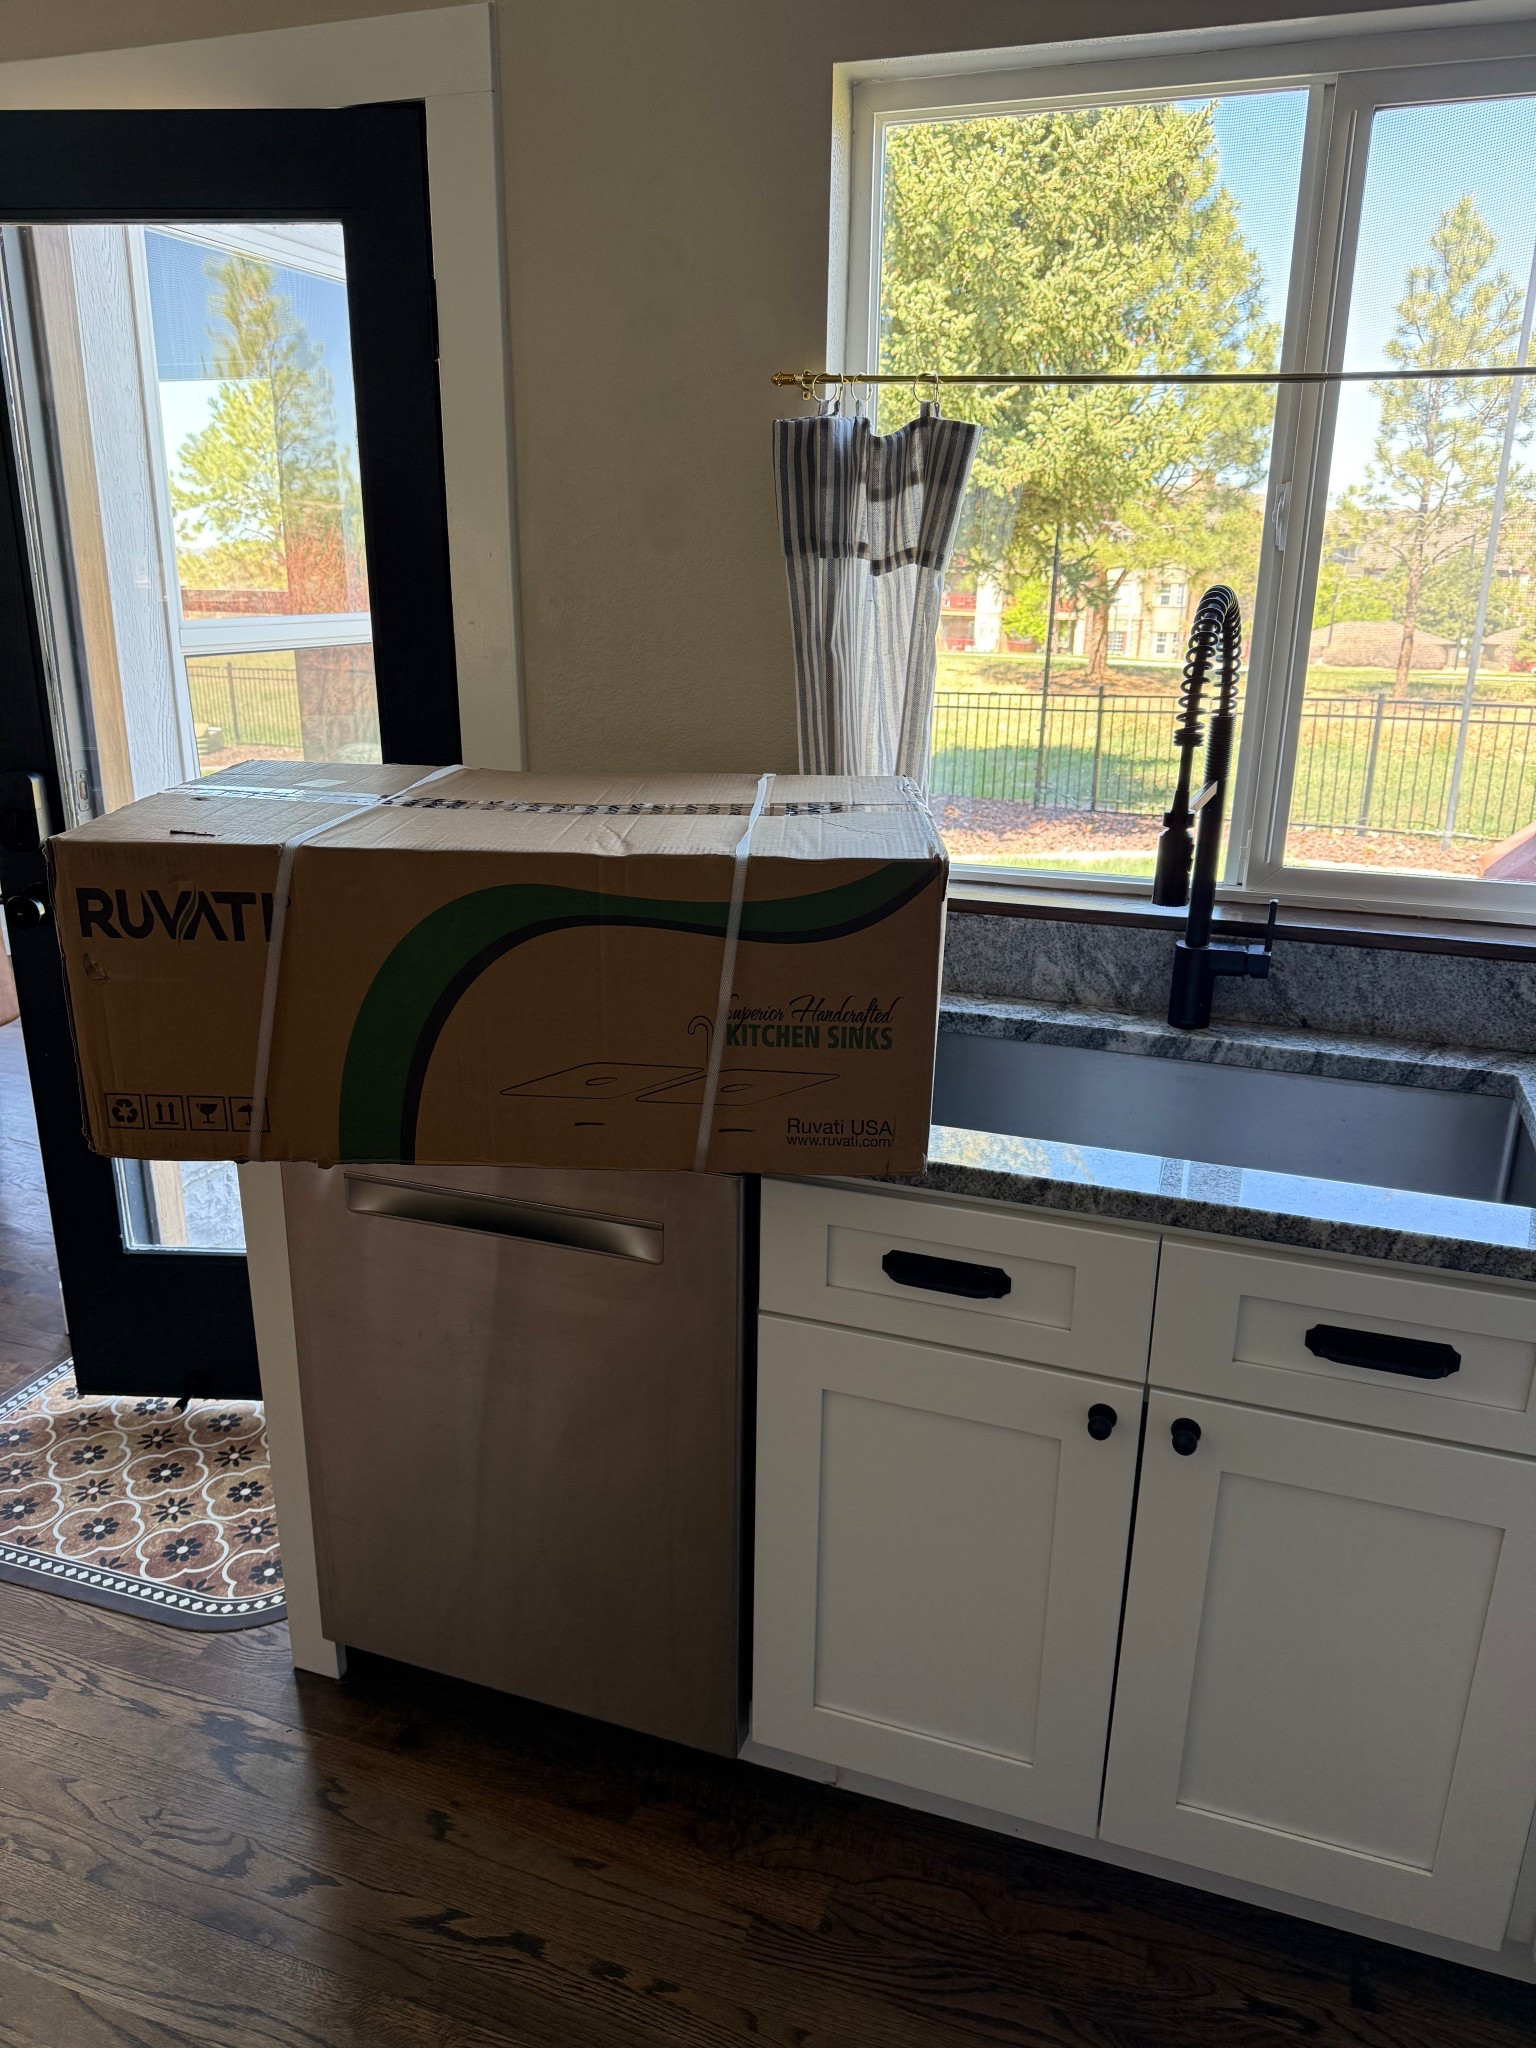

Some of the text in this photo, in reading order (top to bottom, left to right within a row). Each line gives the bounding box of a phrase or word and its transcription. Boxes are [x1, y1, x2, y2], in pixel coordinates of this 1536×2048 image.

[76, 887, 273, 944] RUVATI
[789, 994, 904, 1031] Handcrafted
[726, 1024, 893, 1050] KITCHEN SINKS
[787, 1118, 893, 1136] Ruvati USA
[787, 1136, 891, 1148] www.ruvati.com
